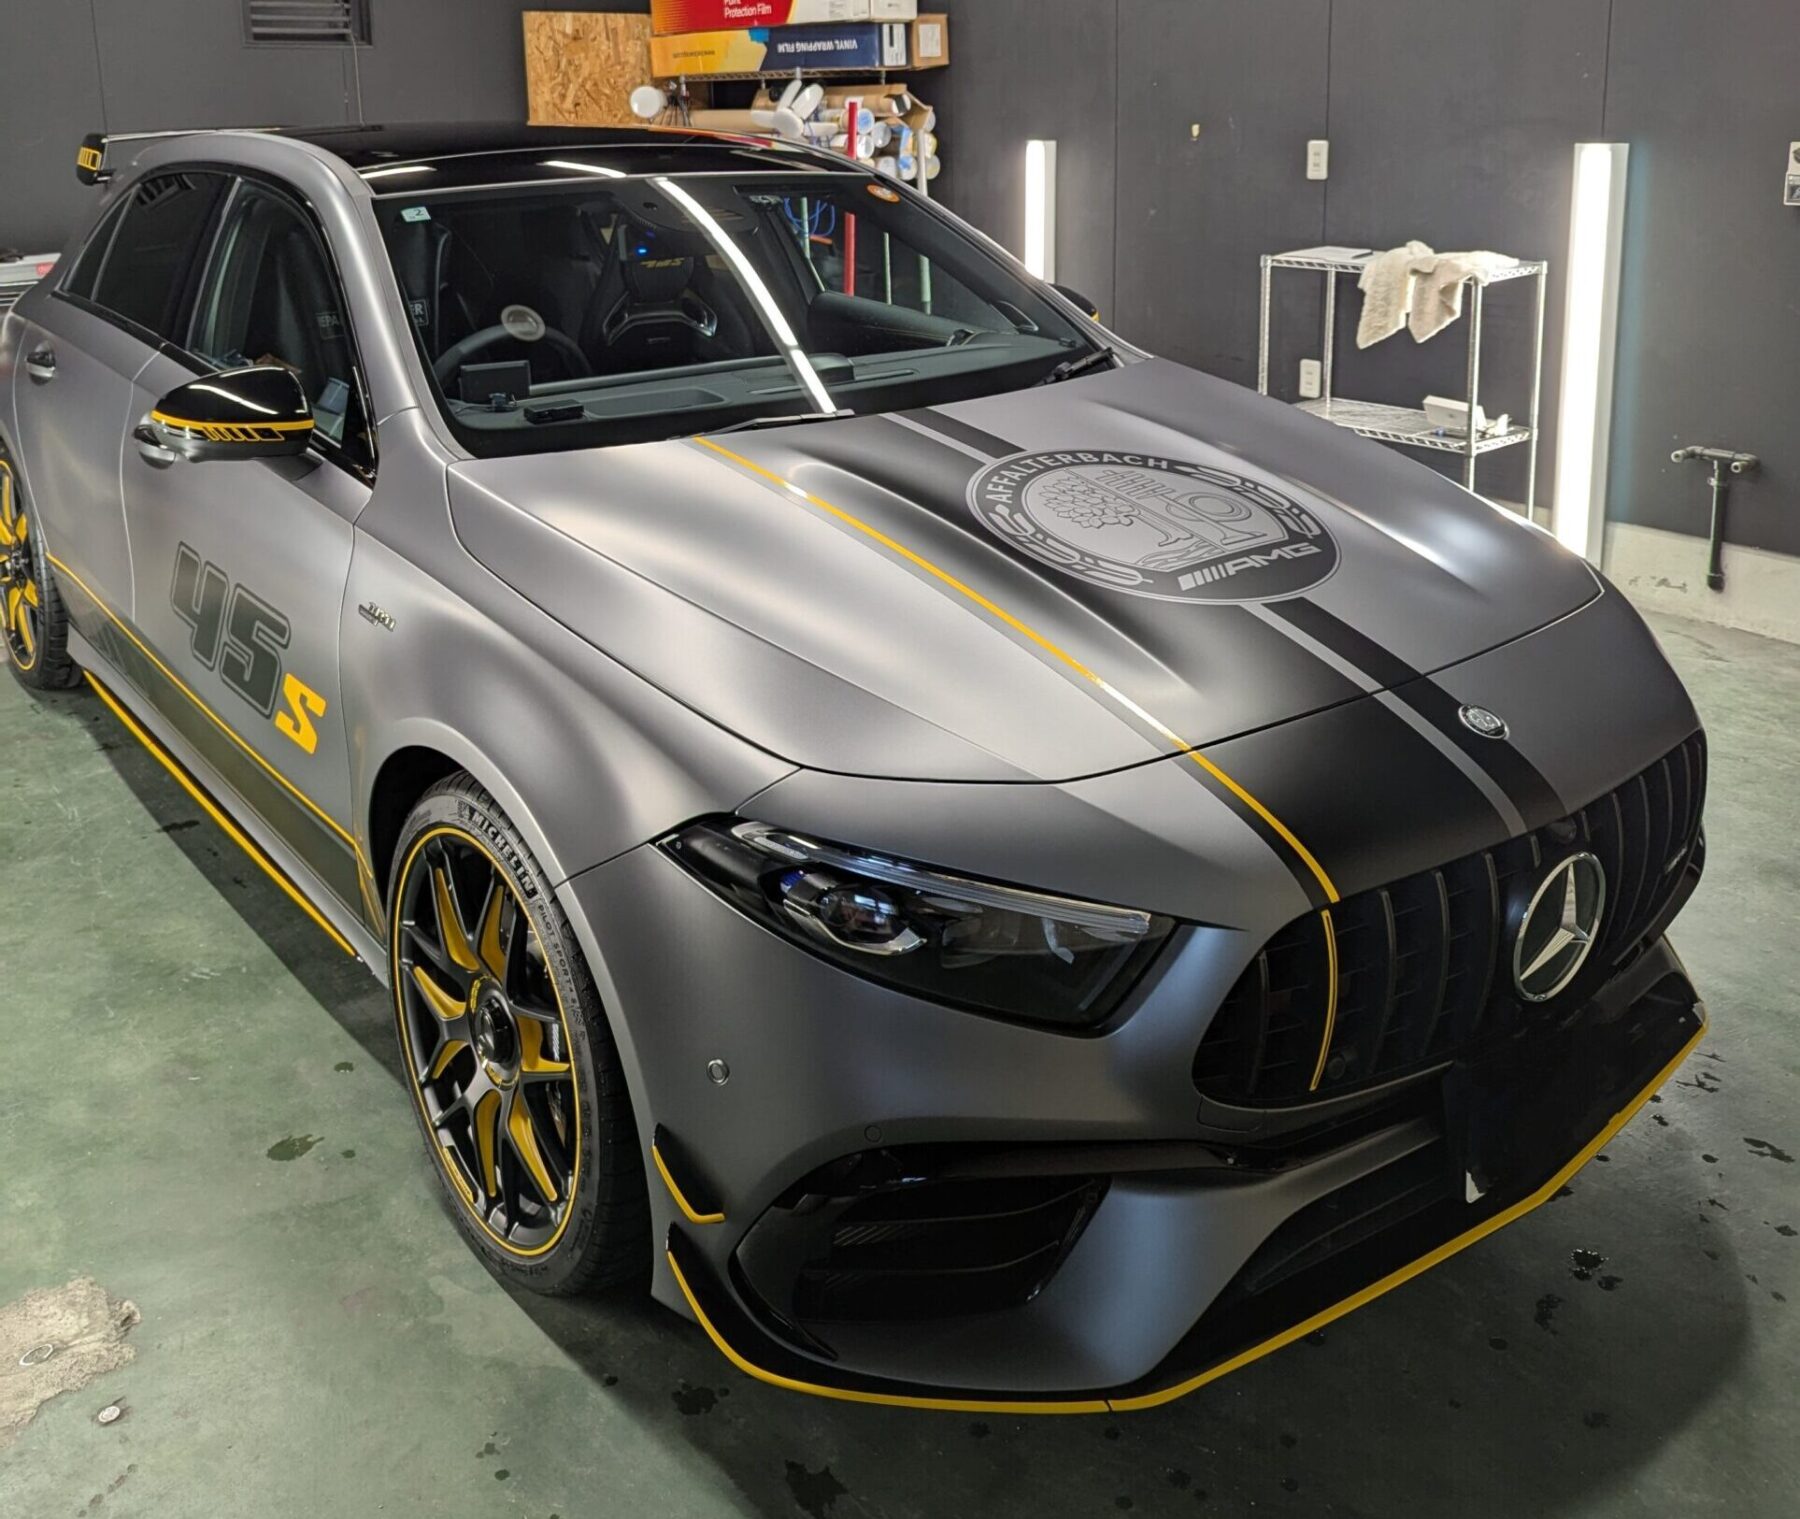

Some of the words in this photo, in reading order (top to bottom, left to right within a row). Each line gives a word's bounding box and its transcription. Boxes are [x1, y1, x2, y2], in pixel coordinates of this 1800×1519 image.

[724, 5, 756, 18] Protection
[757, 3, 772, 15] Film
[777, 43, 795, 53] FILM
[796, 40, 834, 52] WRAPPING
[834, 38, 858, 50] VINYL
[985, 452, 1169, 504] AFFALTERBACH
[170, 540, 291, 720] 45
[274, 673, 327, 755] S
[471, 810, 535, 894] MICHELIN
[537, 904, 555, 937] PILOT
[553, 943, 572, 986] SPORT
